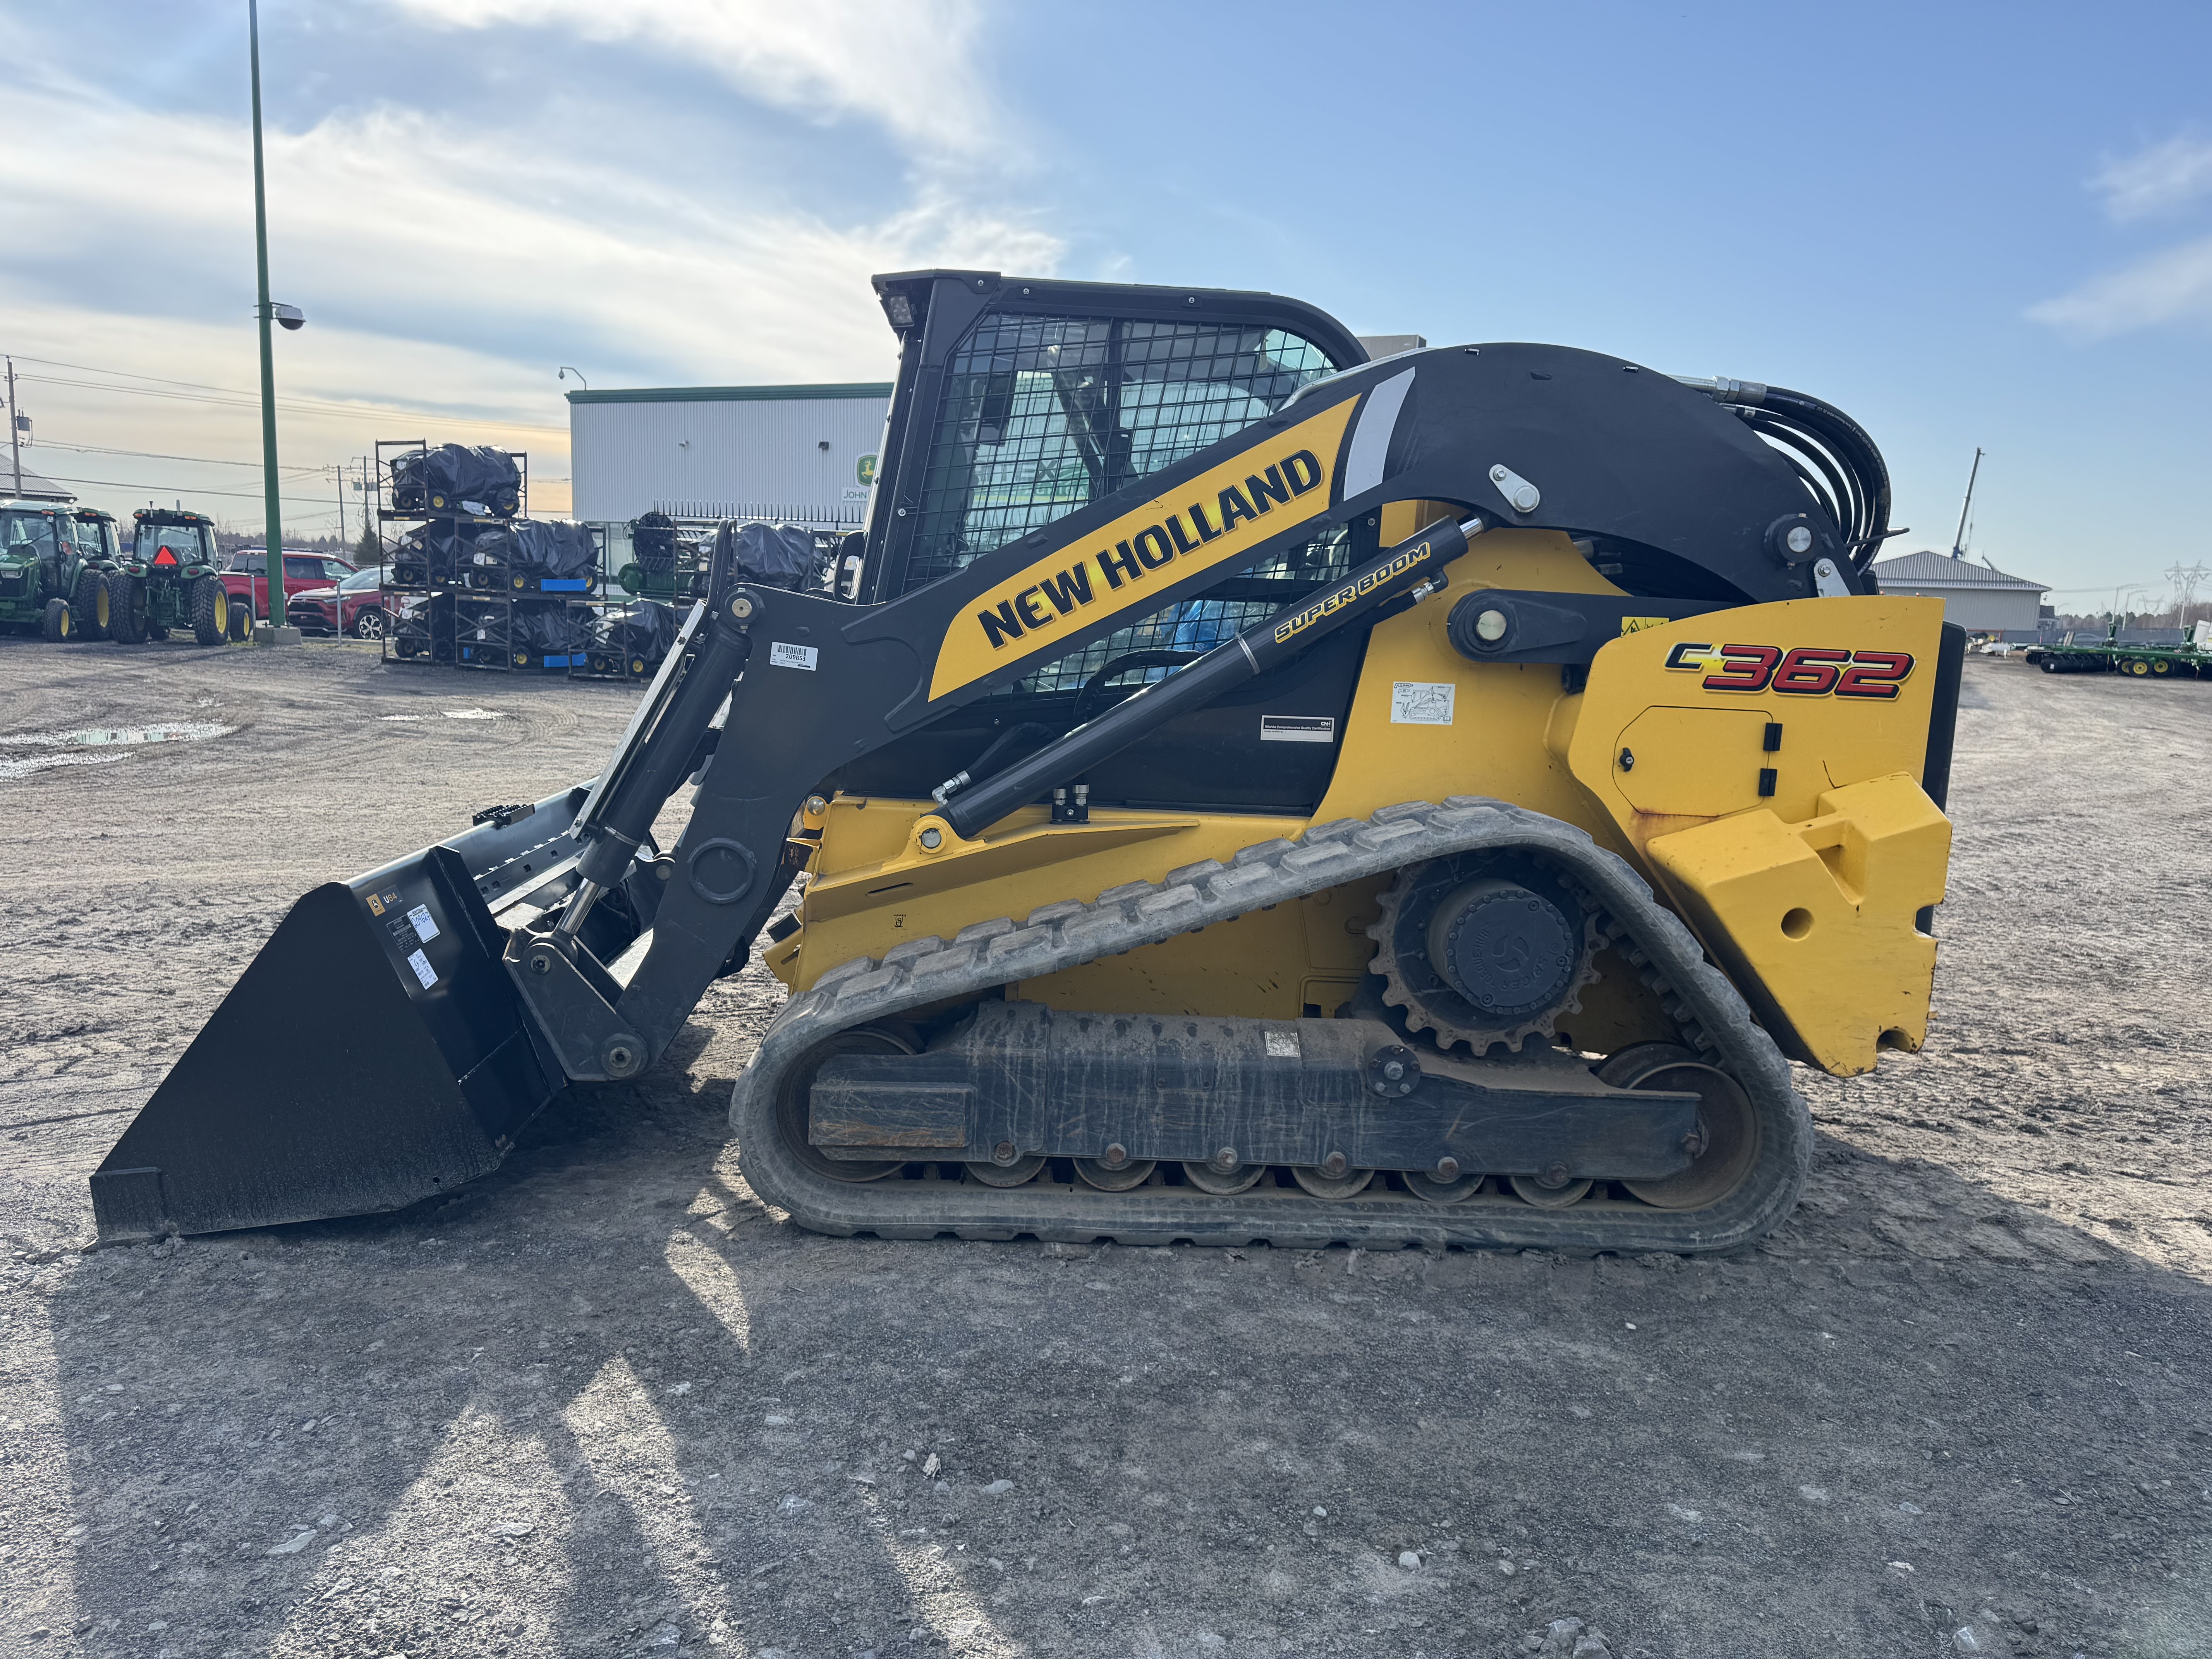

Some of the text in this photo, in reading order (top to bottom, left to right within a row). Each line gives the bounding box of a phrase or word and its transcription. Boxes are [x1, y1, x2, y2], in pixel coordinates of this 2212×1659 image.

[843, 489, 867, 498] JOHN
[977, 449, 1323, 650] NEW HOLLAND
[1274, 542, 1430, 643] SUPER BOOM
[785, 653, 806, 661] 209853
[1500, 956, 1548, 991] SPICER
